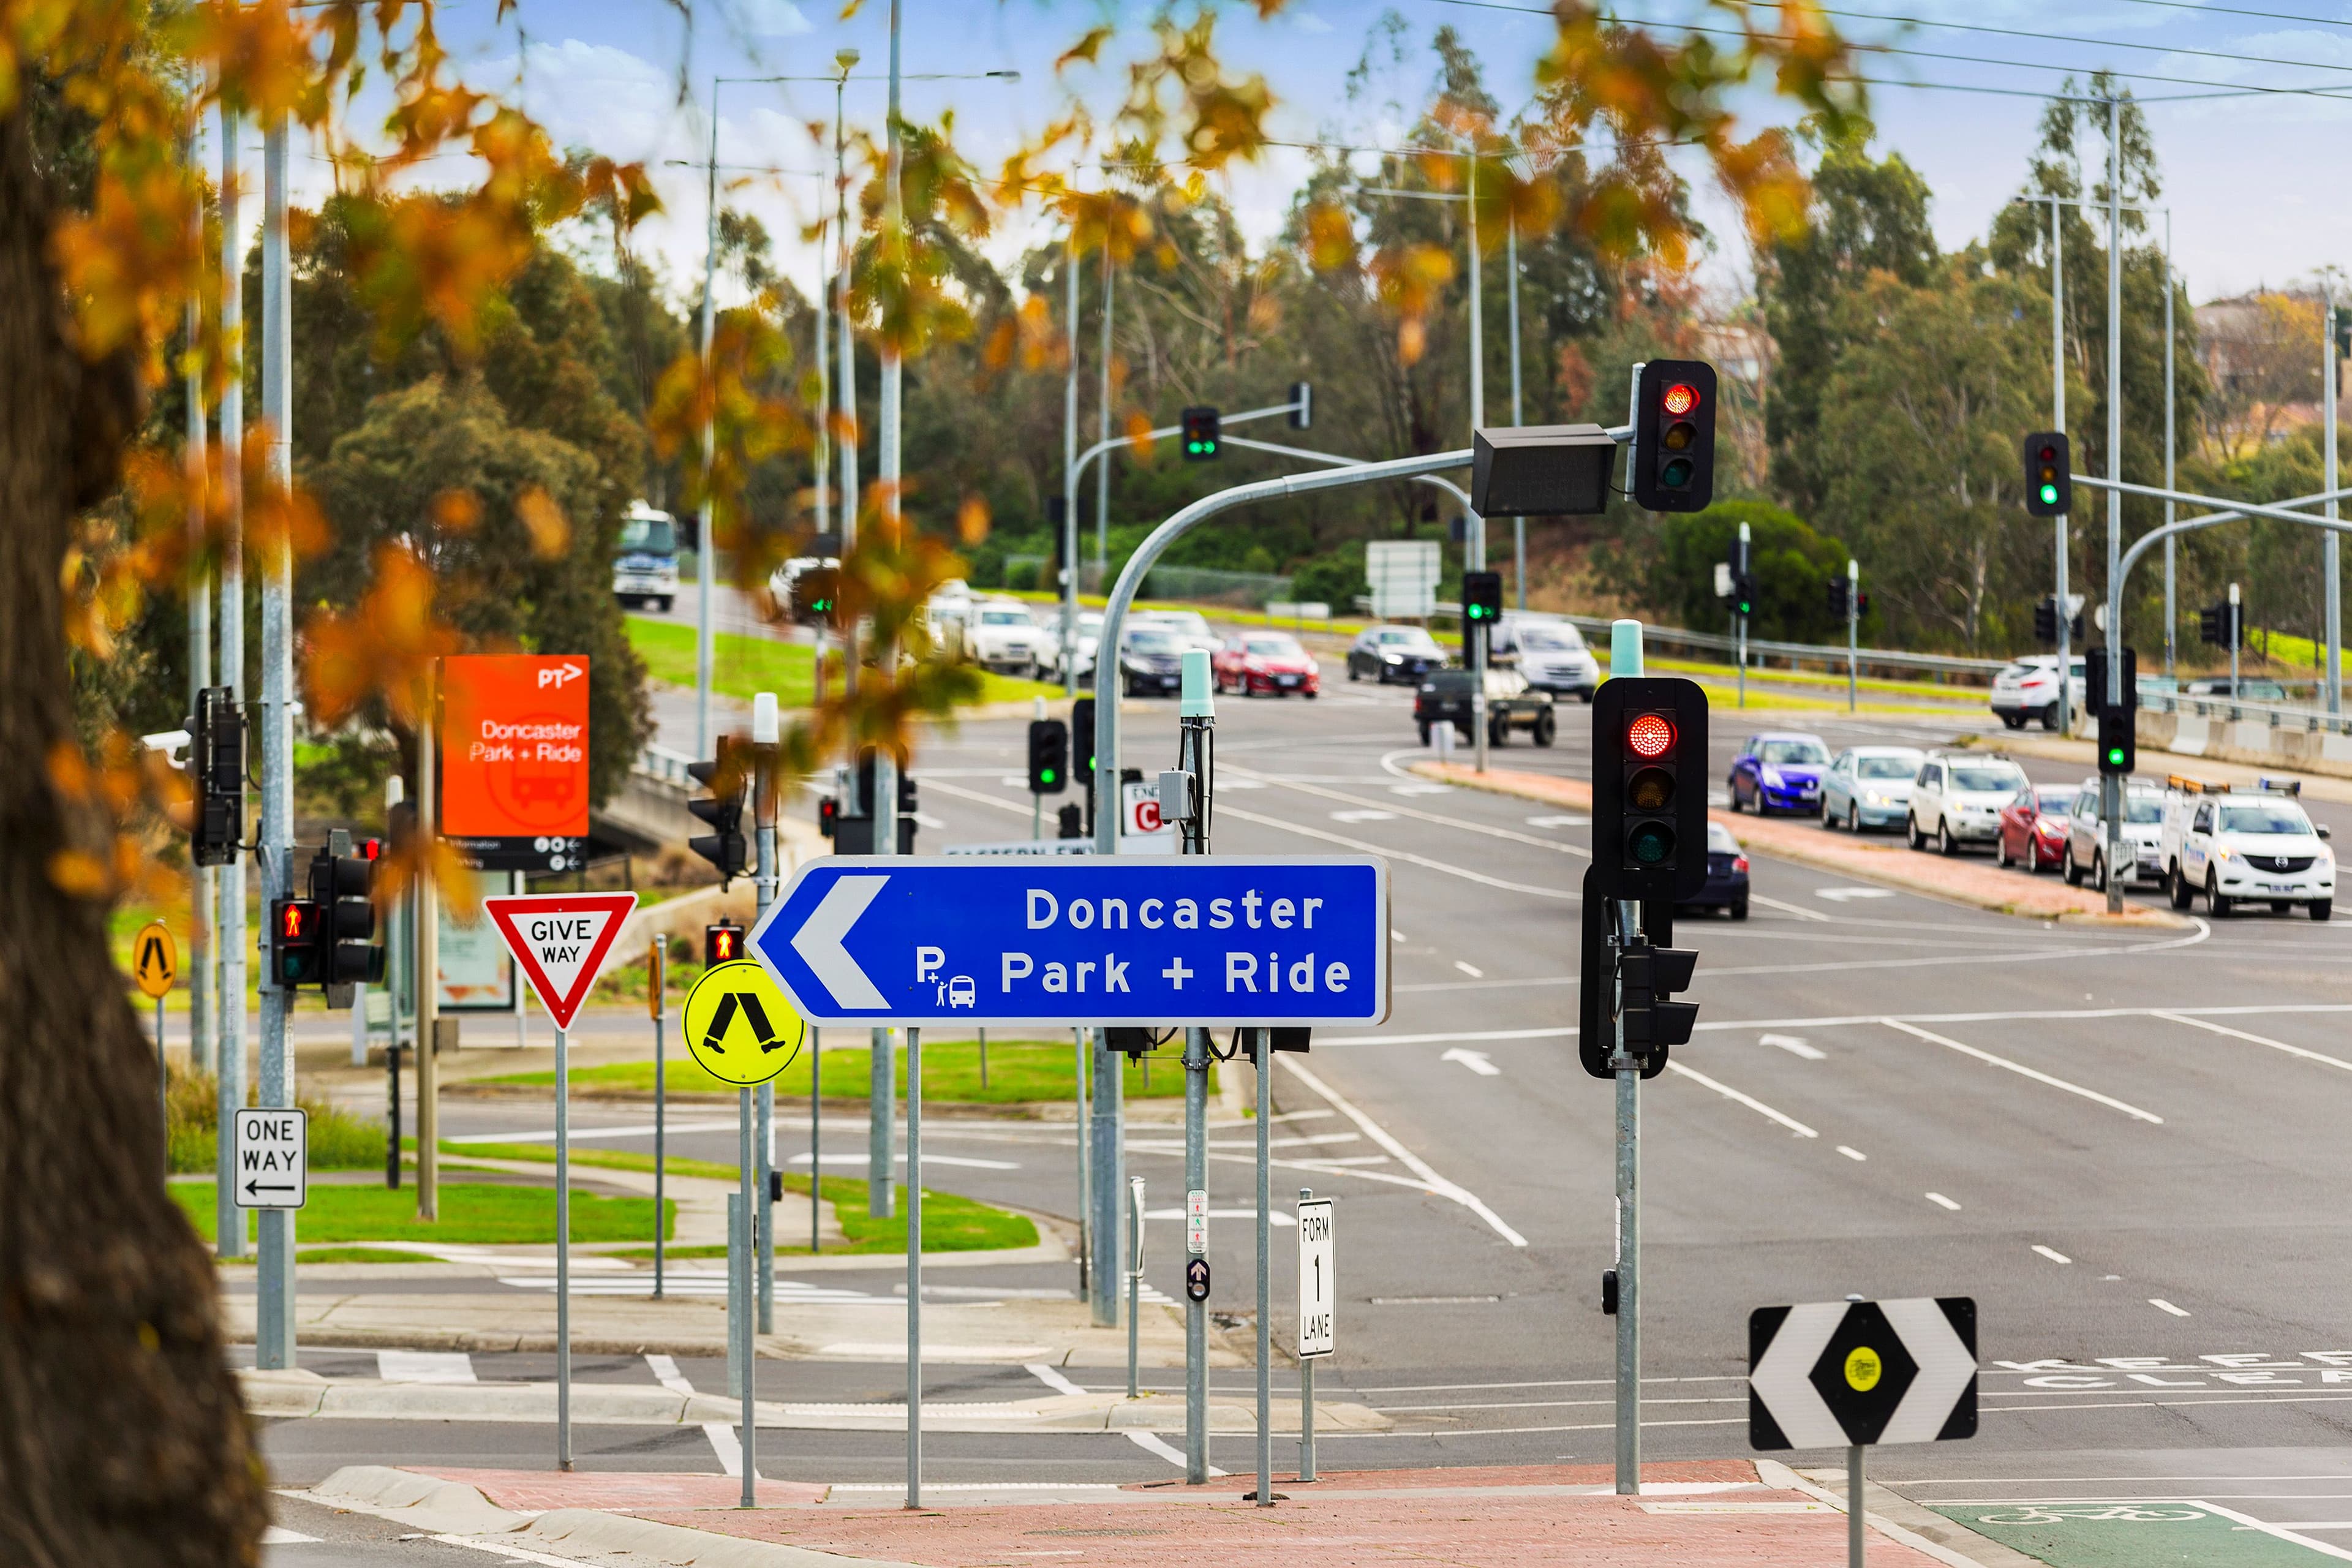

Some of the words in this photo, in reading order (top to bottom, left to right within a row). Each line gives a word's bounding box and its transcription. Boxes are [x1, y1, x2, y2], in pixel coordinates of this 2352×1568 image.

[481, 720, 581, 739] Doncaster
[470, 742, 514, 761] Park
[519, 748, 530, 760] +
[537, 742, 582, 762] Ride
[1140, 803, 1159, 829] C
[450, 839, 501, 850] Information
[1027, 889, 1323, 929] Doncaster
[532, 920, 591, 941] GIVE
[543, 946, 580, 963] WAY
[1002, 952, 1131, 993] Park
[1163, 957, 1194, 990] +
[1226, 952, 1350, 993] Ride
[247, 1120, 293, 1140] ONE
[243, 1150, 296, 1171] WAY
[1303, 1216, 1329, 1242] FORM
[1314, 1254, 1319, 1302] 1
[1304, 1314, 1330, 1340] LANE
[2023, 1370, 2352, 1388] CLE
